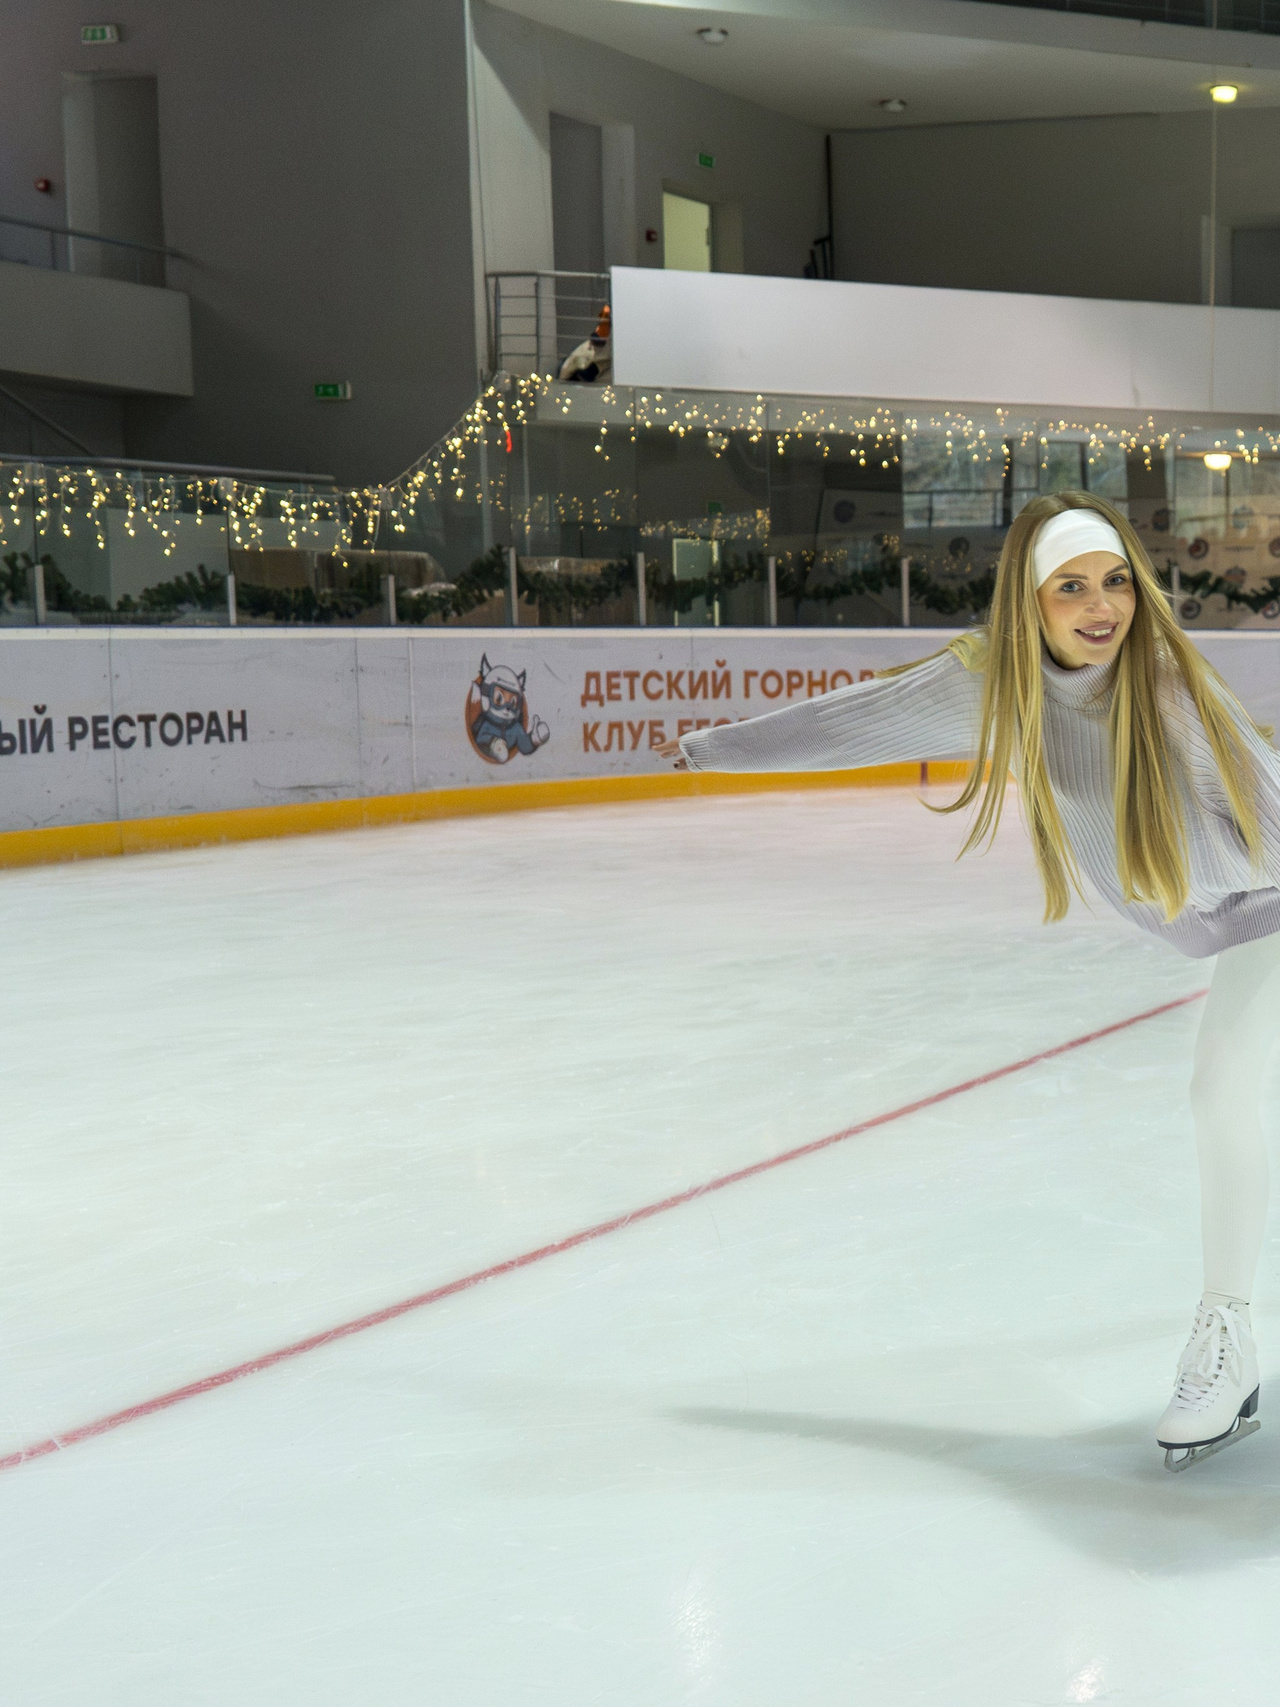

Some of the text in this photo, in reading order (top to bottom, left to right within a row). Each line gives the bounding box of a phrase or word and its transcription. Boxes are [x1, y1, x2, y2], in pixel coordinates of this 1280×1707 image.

[580, 658, 733, 708] ДЕТСКИЙ
[67, 709, 249, 752] РЕСТОРАН
[582, 718, 668, 753] КЛУБ
